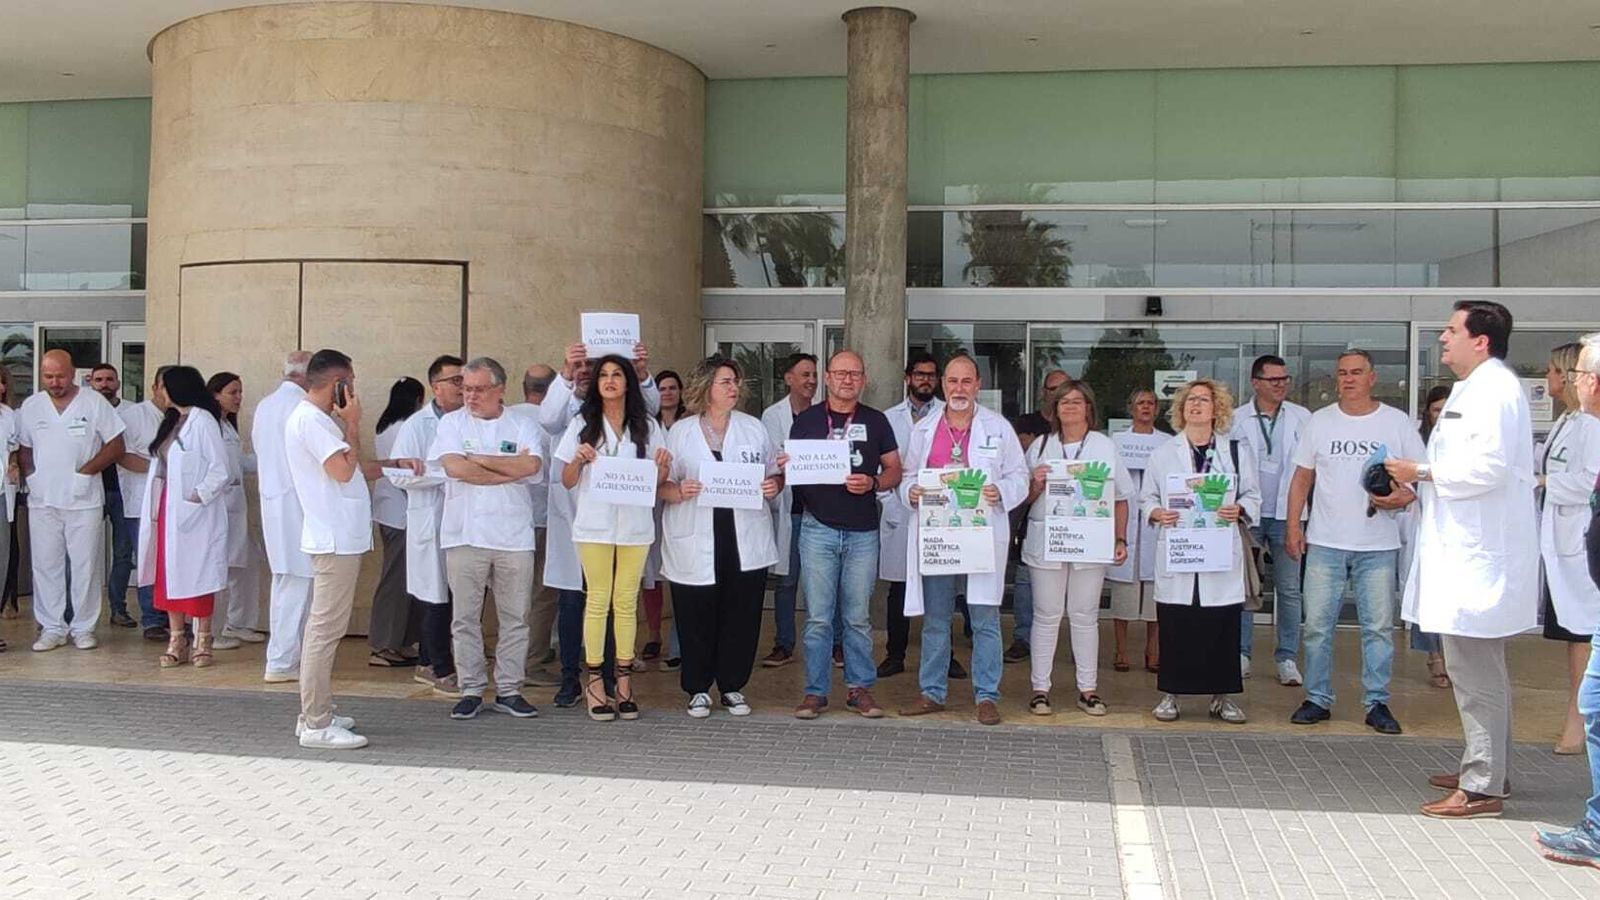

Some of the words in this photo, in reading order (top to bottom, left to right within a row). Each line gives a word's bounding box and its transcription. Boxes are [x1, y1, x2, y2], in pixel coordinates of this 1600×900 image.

[1330, 440, 1380, 455] BOSS
[799, 454, 811, 462] NO
[791, 462, 847, 471] AGRESIONES
[603, 472, 618, 480] NO
[619, 473, 626, 481] A
[595, 482, 652, 492] AGRESIONES
[703, 487, 759, 496] AGRESIONES
[1049, 546, 1084, 554] AGRESIÓN
[923, 557, 961, 565] AGRESIÓN
